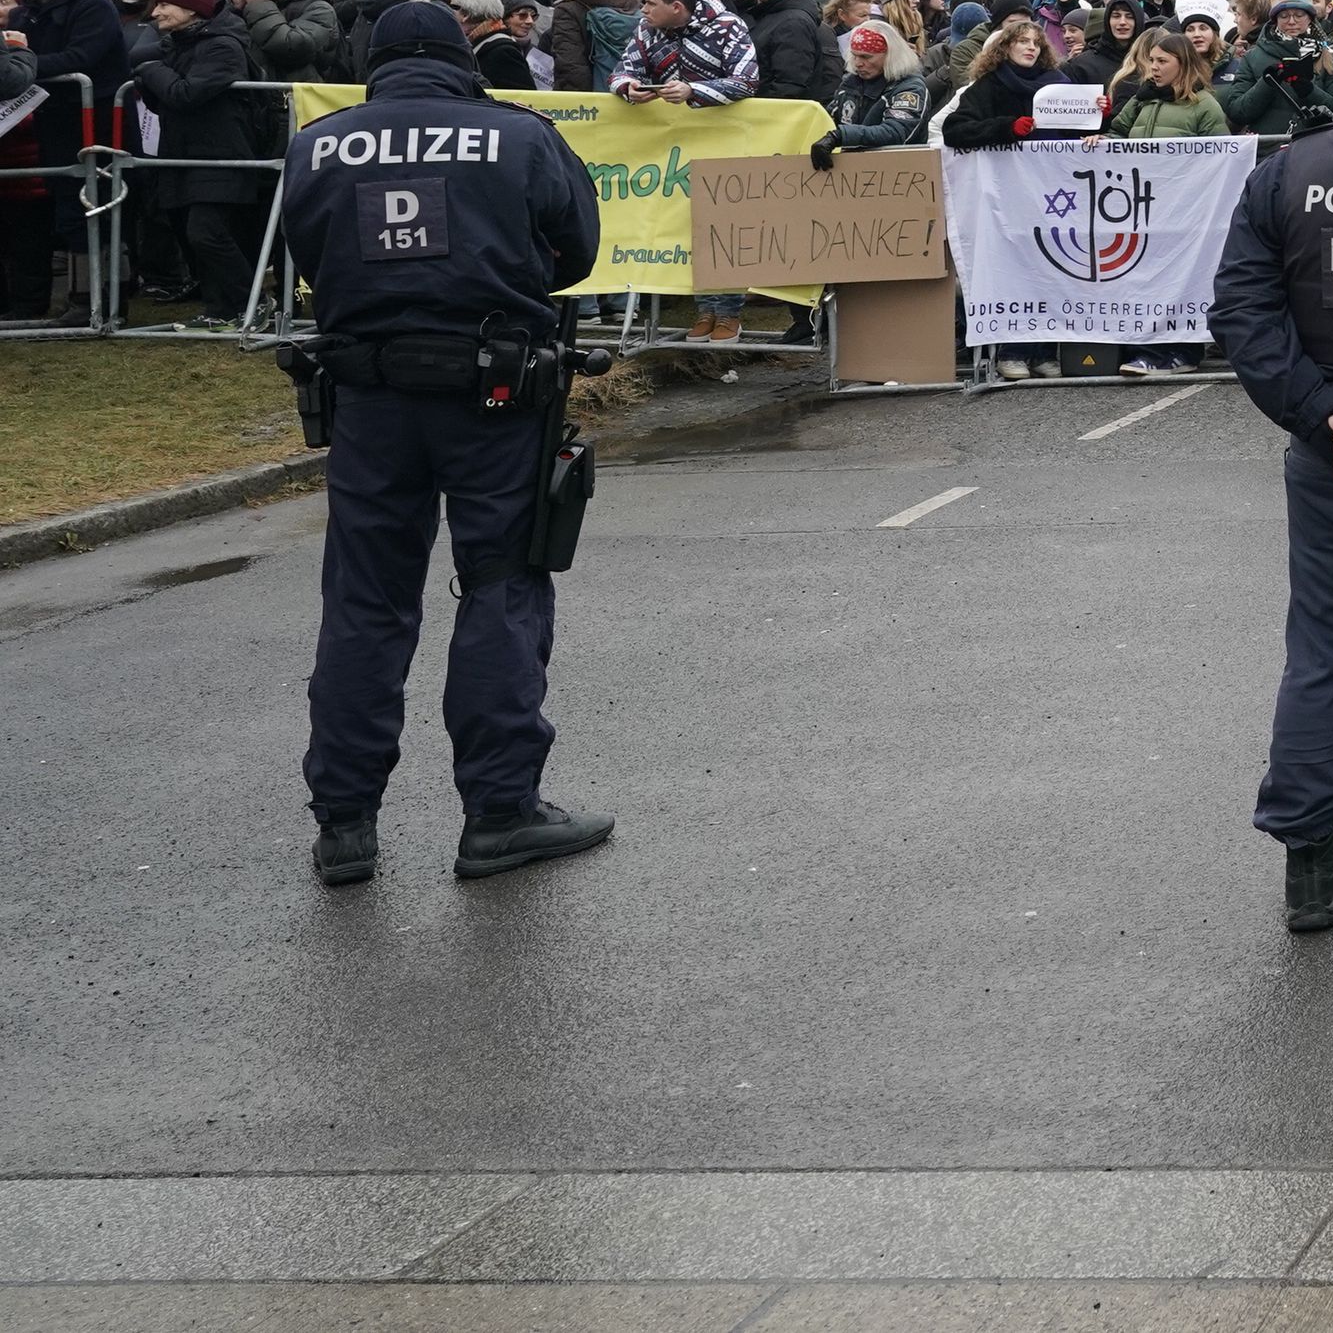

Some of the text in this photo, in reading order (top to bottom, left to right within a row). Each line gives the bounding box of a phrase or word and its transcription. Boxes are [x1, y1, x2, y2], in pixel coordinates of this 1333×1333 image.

[1047, 98, 1090, 106] NIE WIEDER
[311, 128, 500, 170] POLIZEI
[1030, 142, 1075, 154] UNION
[1081, 142, 1100, 154] OF
[1106, 142, 1160, 154] JEWISH
[1166, 142, 1238, 155] STUDENTS
[384, 190, 420, 224] D
[378, 226, 428, 250] 151
[611, 244, 692, 265] brauch
[1062, 299, 1208, 316] ÖSTERREICHISC
[976, 317, 1197, 334] OCHSCHÜLERINN
